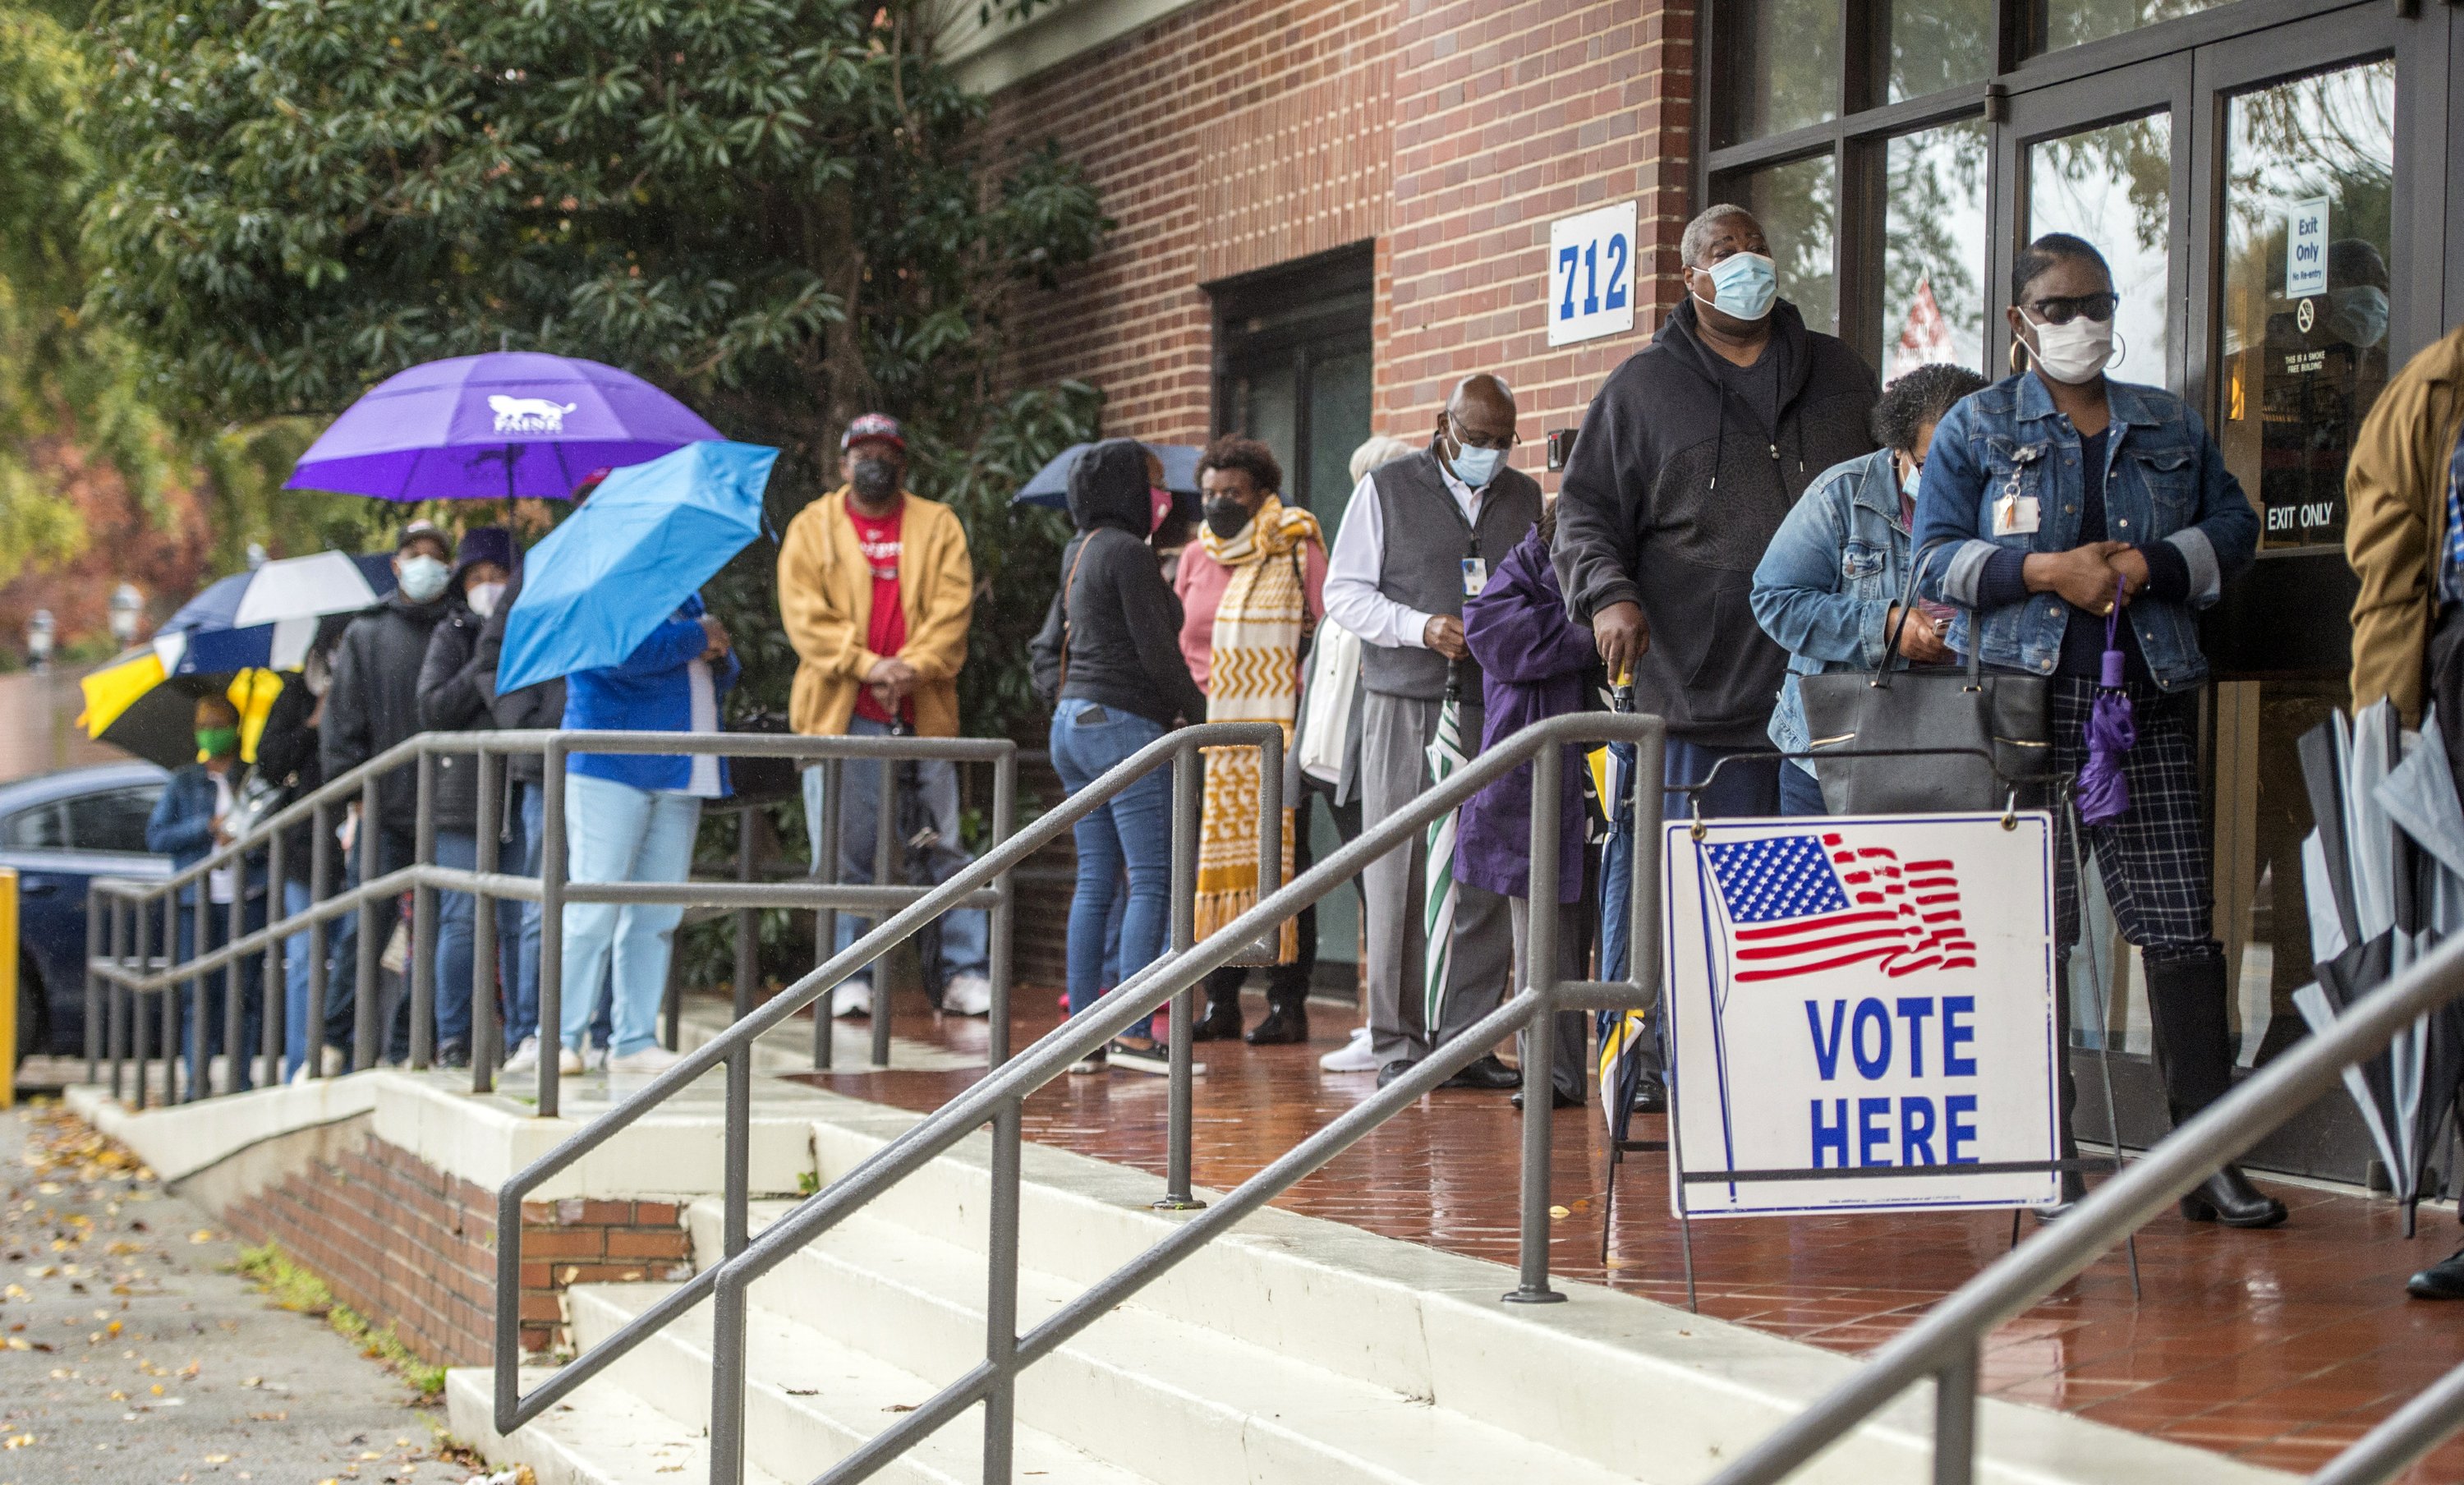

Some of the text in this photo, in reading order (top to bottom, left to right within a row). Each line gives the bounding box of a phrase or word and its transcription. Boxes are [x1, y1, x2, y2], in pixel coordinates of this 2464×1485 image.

[2299, 217, 2318, 236] Exit
[2296, 241, 2319, 262] Only
[1559, 232, 1628, 321] 712
[2292, 269, 2322, 281] No Re-entry
[2285, 350, 2325, 366] THIS IS A SMOKE
[2287, 361, 2323, 374] FREE BUILDING
[2268, 502, 2333, 531] EXIT ONLY
[1804, 995, 1978, 1080] VOTE
[1810, 1094, 1980, 1170] HERE
